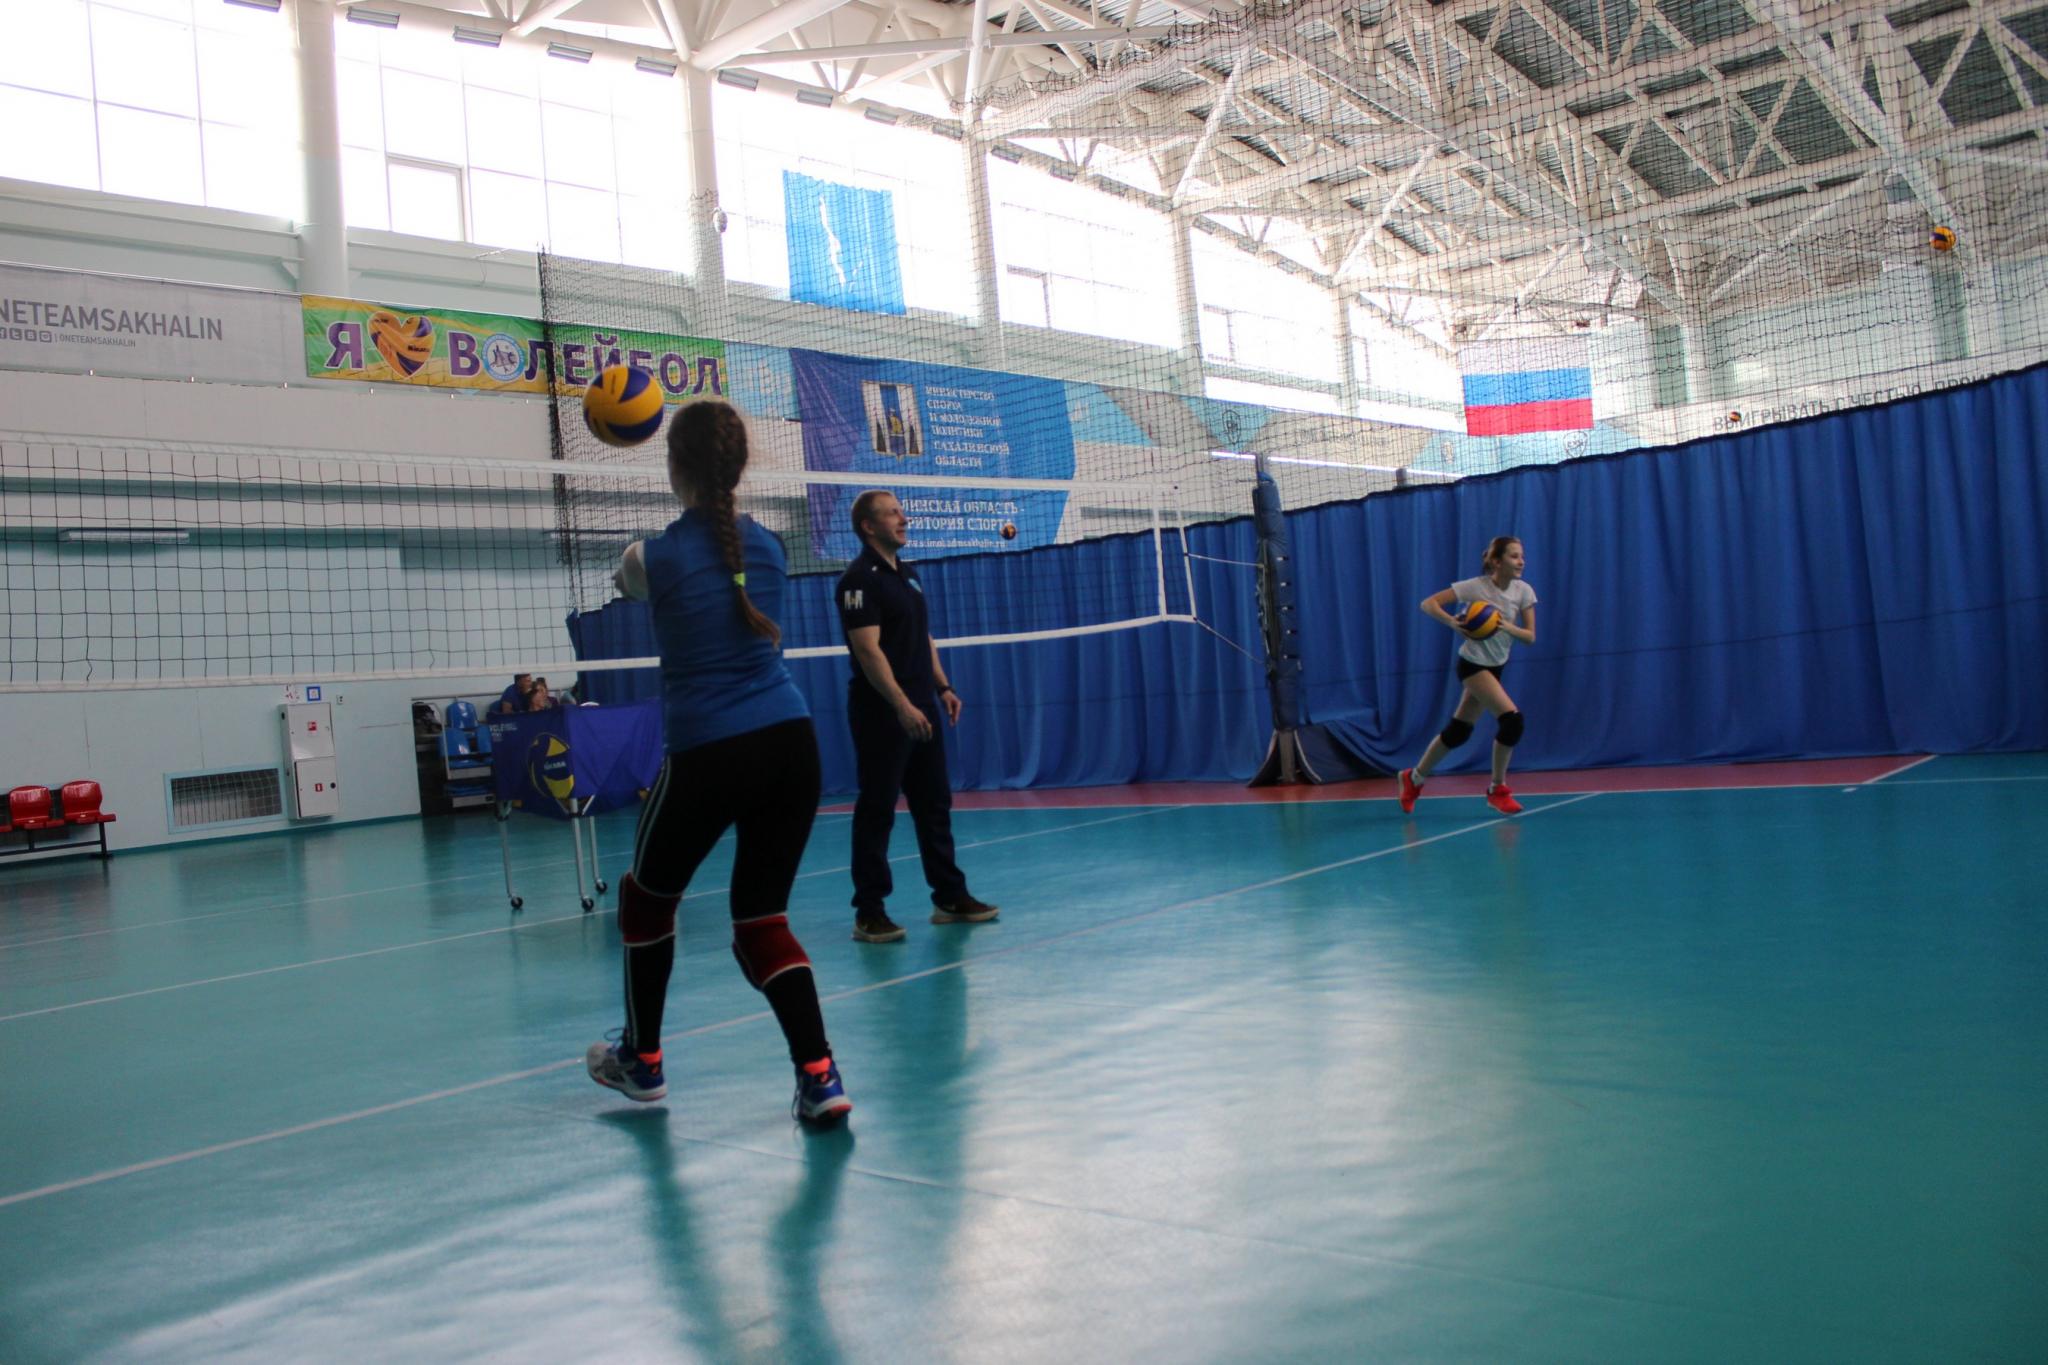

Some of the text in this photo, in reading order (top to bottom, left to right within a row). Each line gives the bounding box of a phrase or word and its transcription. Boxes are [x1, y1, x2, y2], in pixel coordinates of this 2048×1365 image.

[59, 333, 136, 347] ONETEAMSAKHALIN
[326, 323, 363, 369] Я
[901, 499, 960, 512] ЛИНСКАЯ
[963, 502, 1018, 514] ОБЛАСТЬ
[906, 517, 964, 530] РИТОРИЯ
